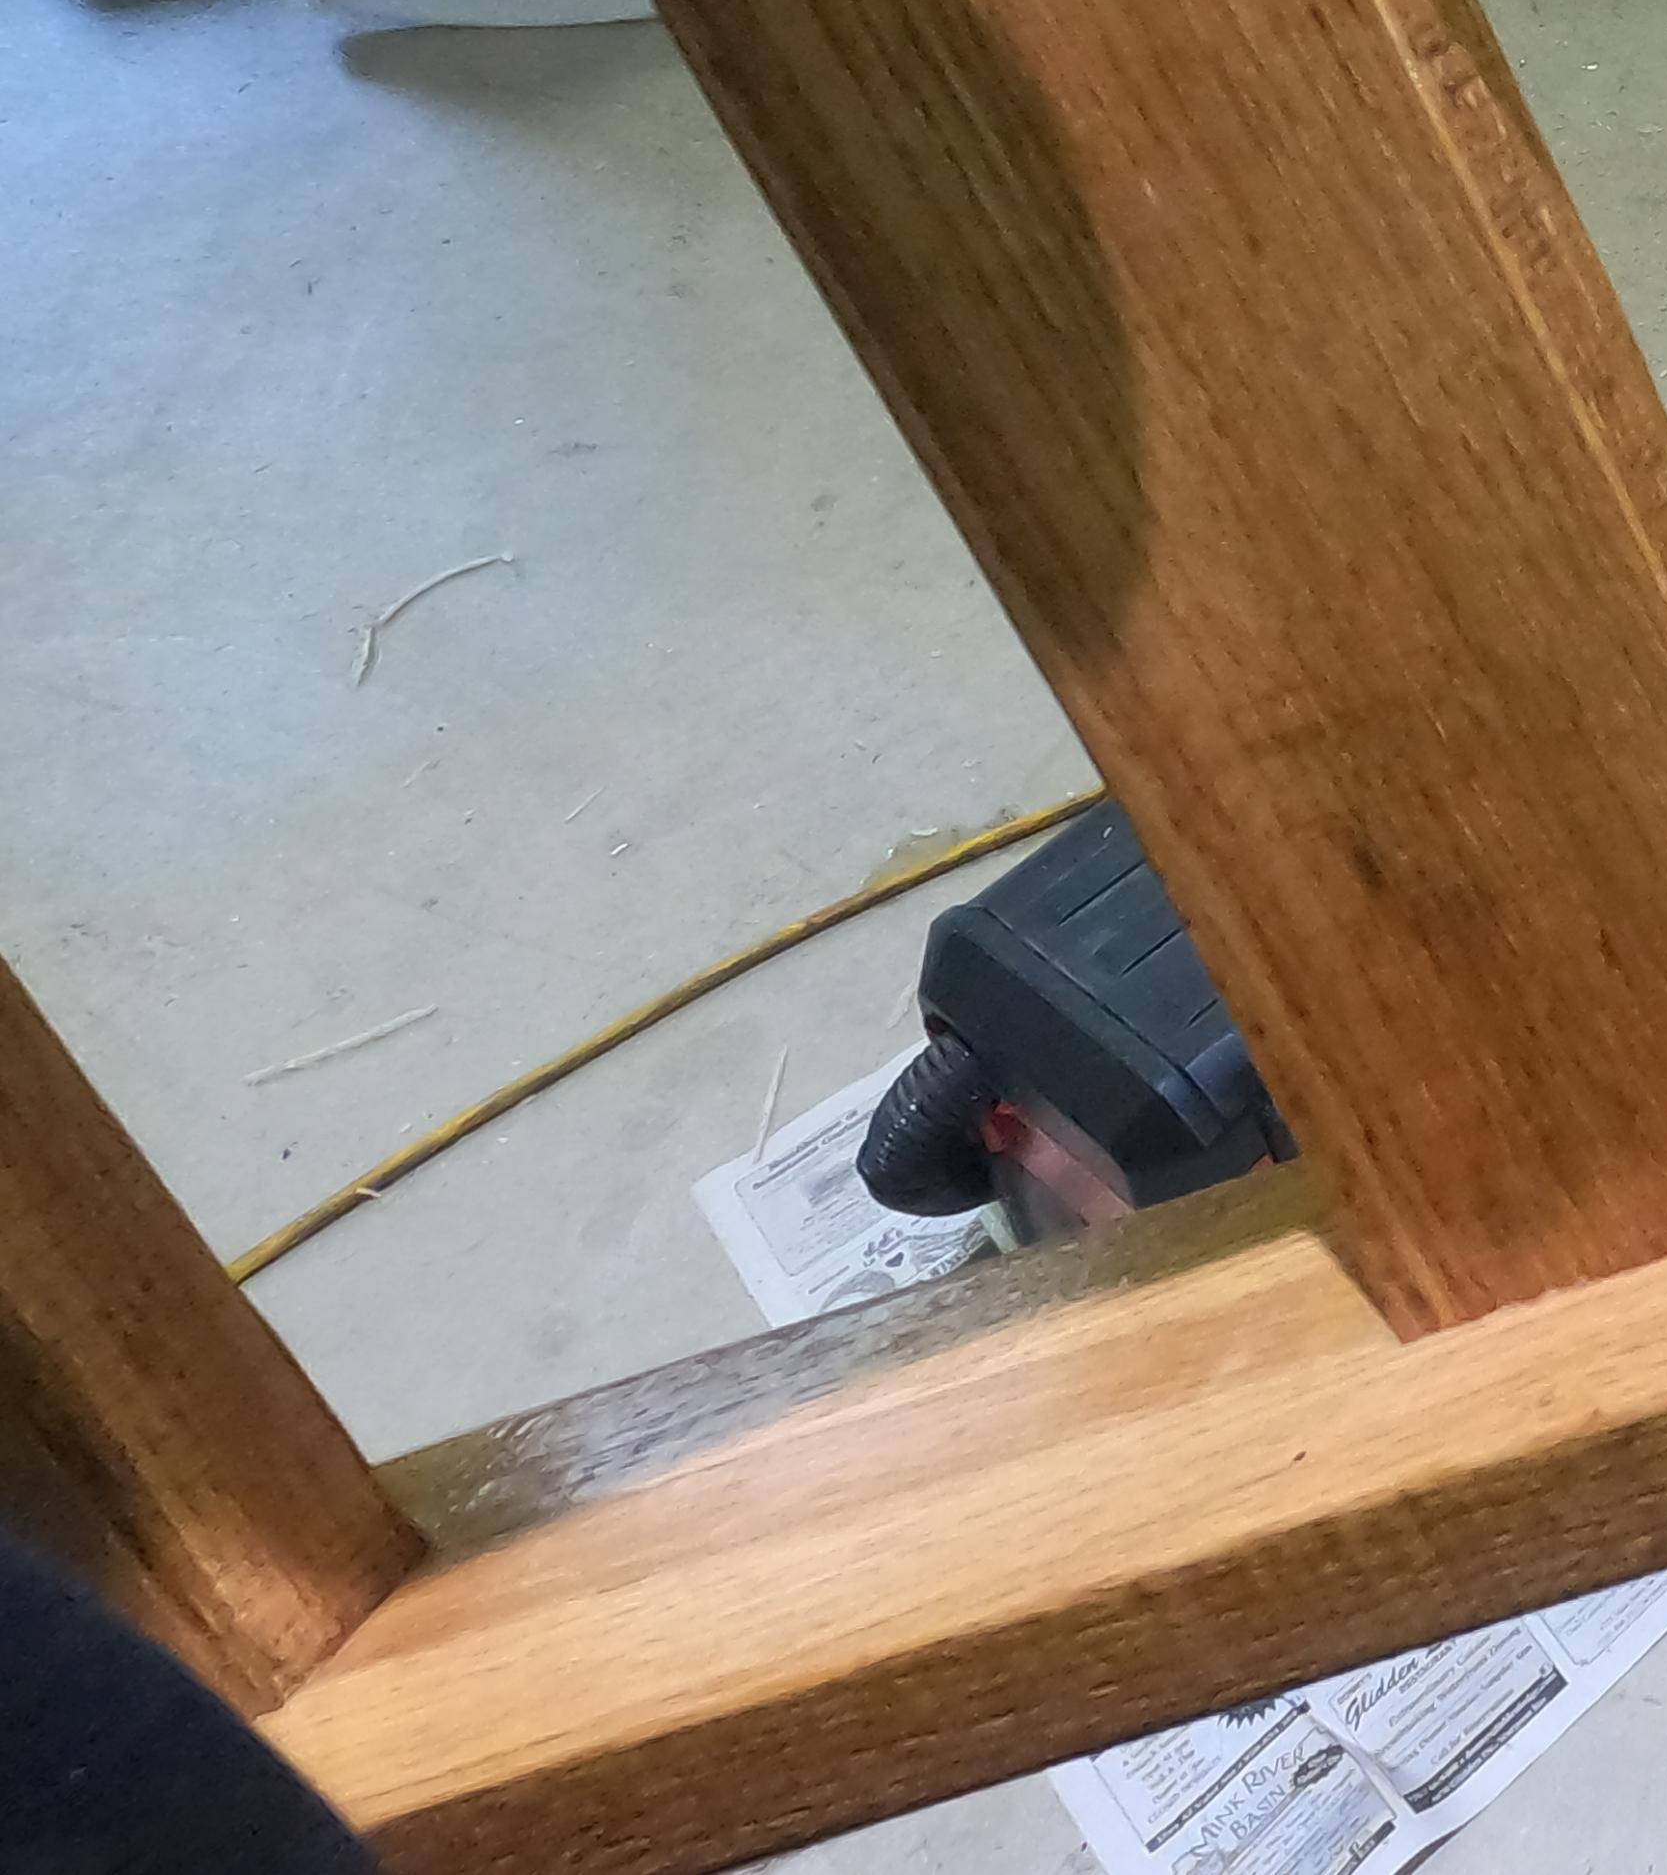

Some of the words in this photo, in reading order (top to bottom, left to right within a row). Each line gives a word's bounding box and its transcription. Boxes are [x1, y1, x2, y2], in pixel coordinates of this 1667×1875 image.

[1345, 1658, 1419, 1732] Glidden
[1189, 1796, 1247, 1859] MINK
[1242, 1744, 1305, 1795] RIVER
[1228, 1787, 1287, 1841] BASIN
